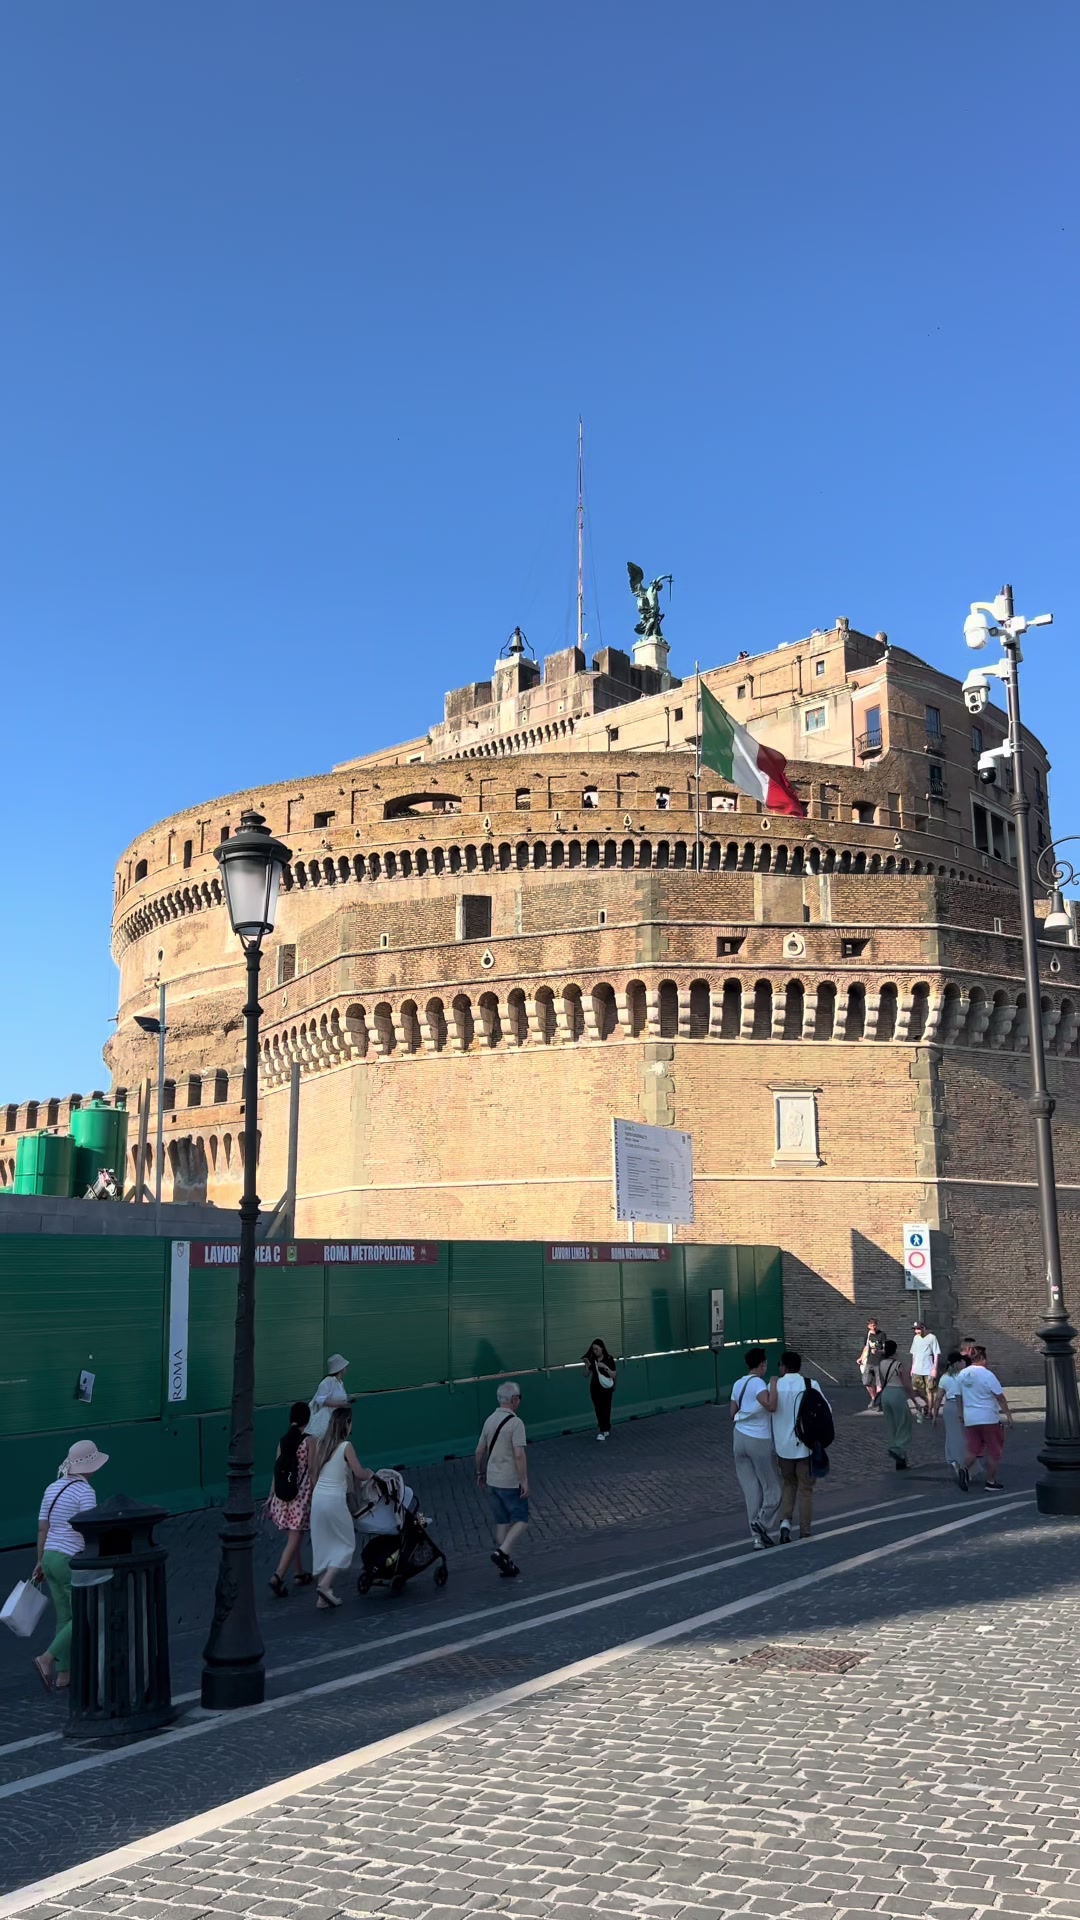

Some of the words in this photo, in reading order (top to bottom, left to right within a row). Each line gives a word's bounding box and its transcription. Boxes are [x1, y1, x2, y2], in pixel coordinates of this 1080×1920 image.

[273, 1245, 281, 1262] C
[323, 1245, 350, 1261] ROMA
[351, 1245, 415, 1261] METROPOLITANE
[552, 1247, 570, 1260] LAVORI
[571, 1247, 585, 1260] LINEA
[586, 1247, 590, 1260] C
[173, 1349, 183, 1400] ROMA
